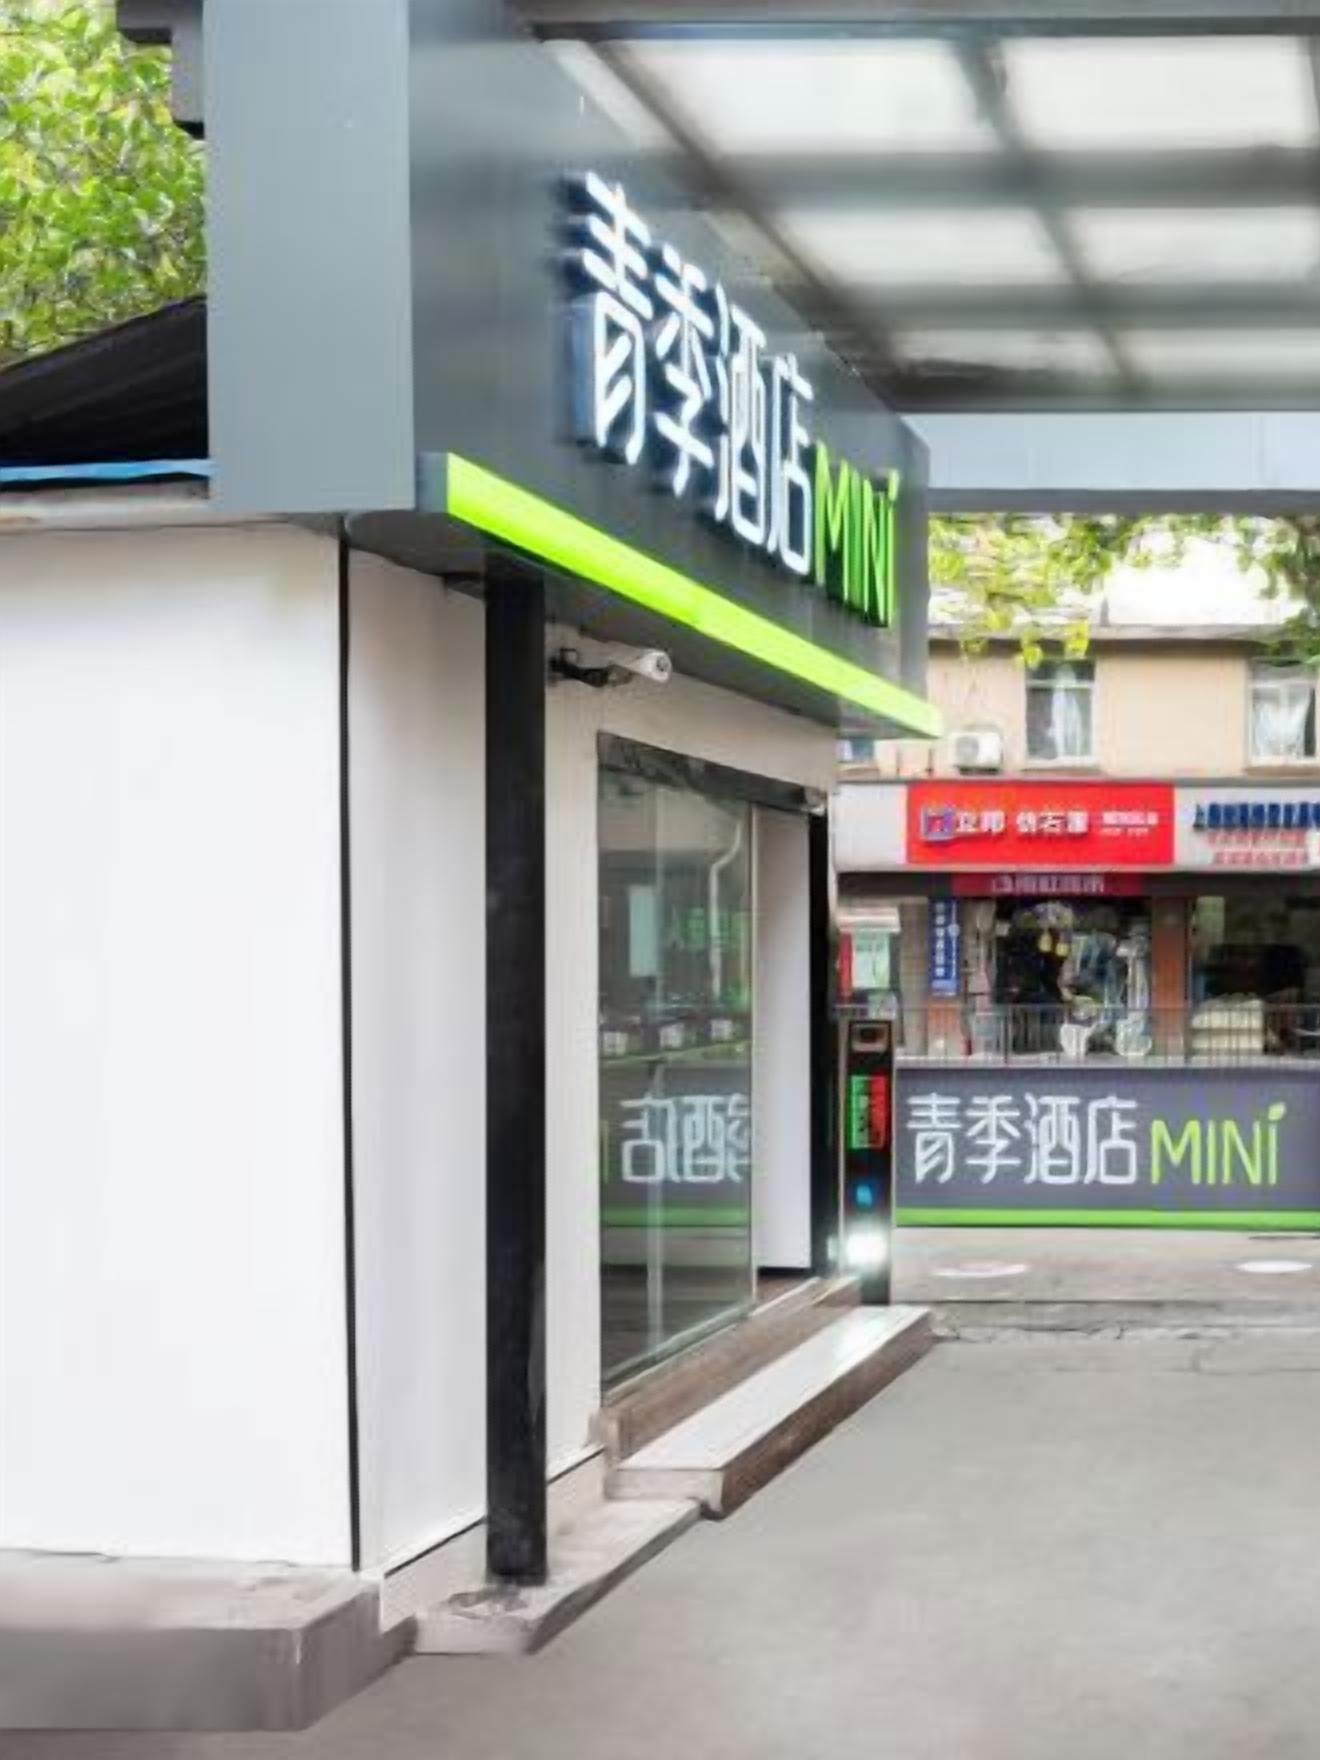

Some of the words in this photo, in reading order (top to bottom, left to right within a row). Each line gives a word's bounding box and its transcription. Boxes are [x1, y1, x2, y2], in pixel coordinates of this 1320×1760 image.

[583, 172, 814, 576] 青季酒店
[906, 1092, 1138, 1186] 青季酒店
